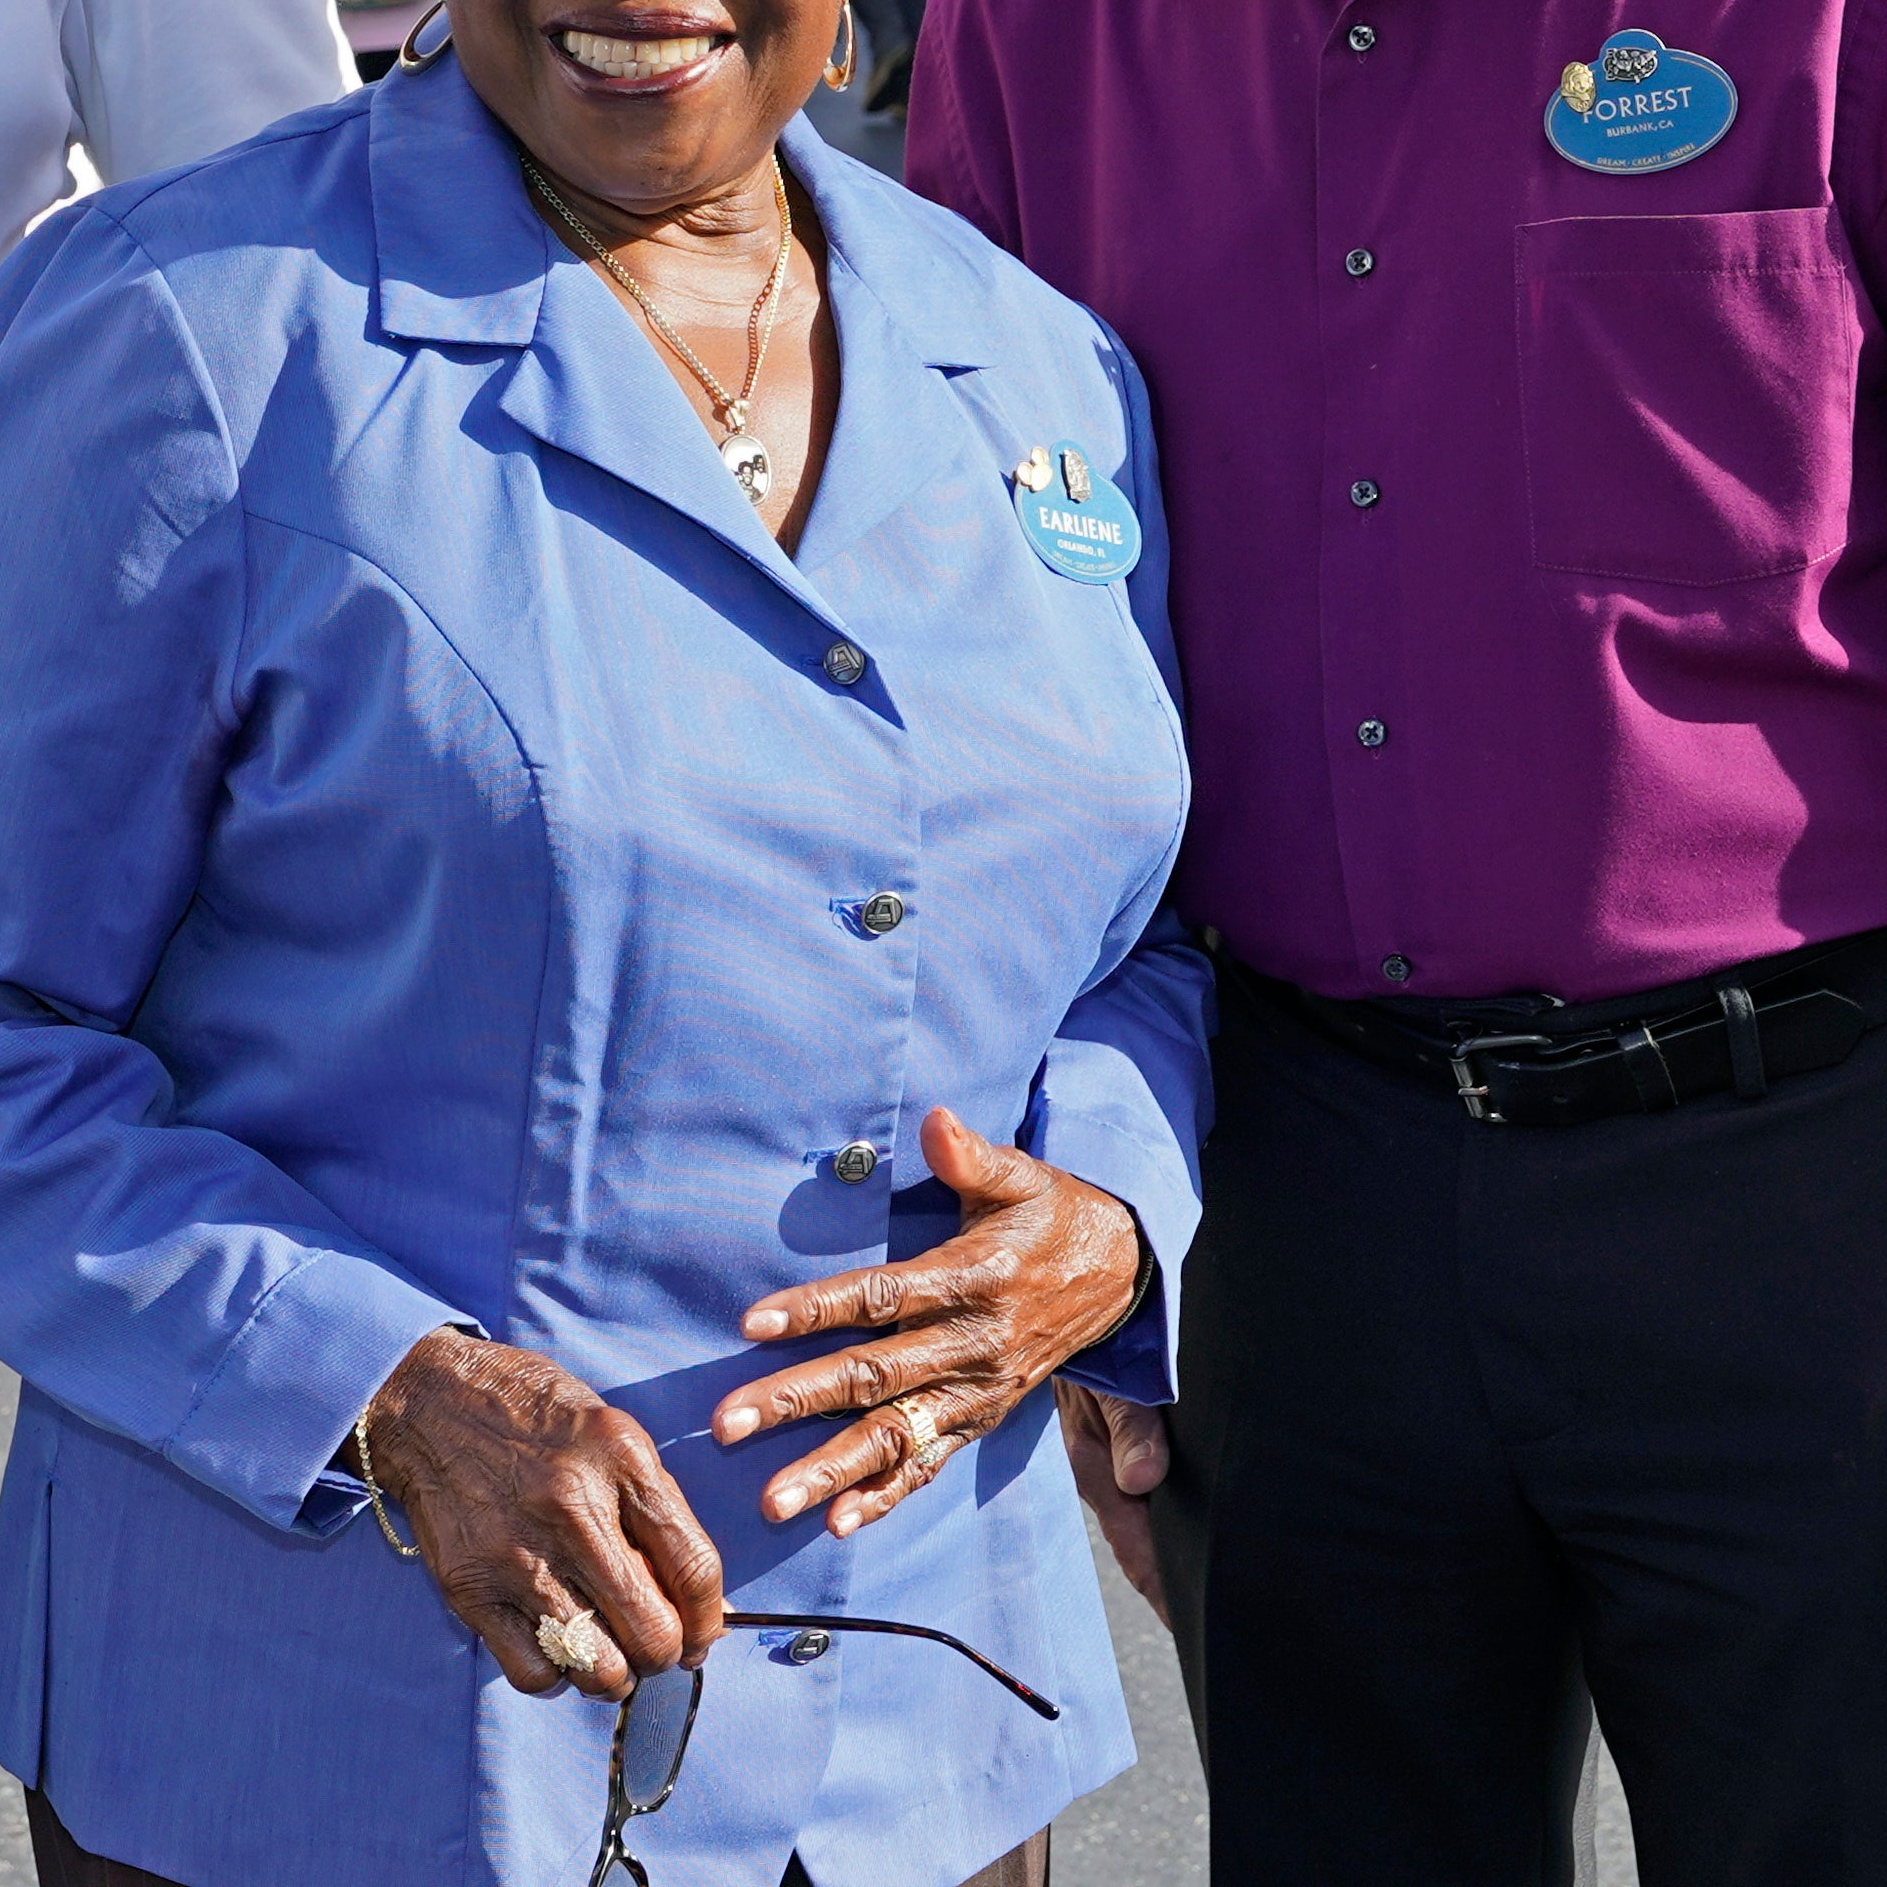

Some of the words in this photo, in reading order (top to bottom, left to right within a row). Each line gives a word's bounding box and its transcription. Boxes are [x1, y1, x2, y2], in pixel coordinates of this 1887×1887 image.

[1606, 122, 1658, 137] BURBANK,
[1658, 119, 1674, 130] CA
[1038, 506, 1124, 545] EARLIENE
